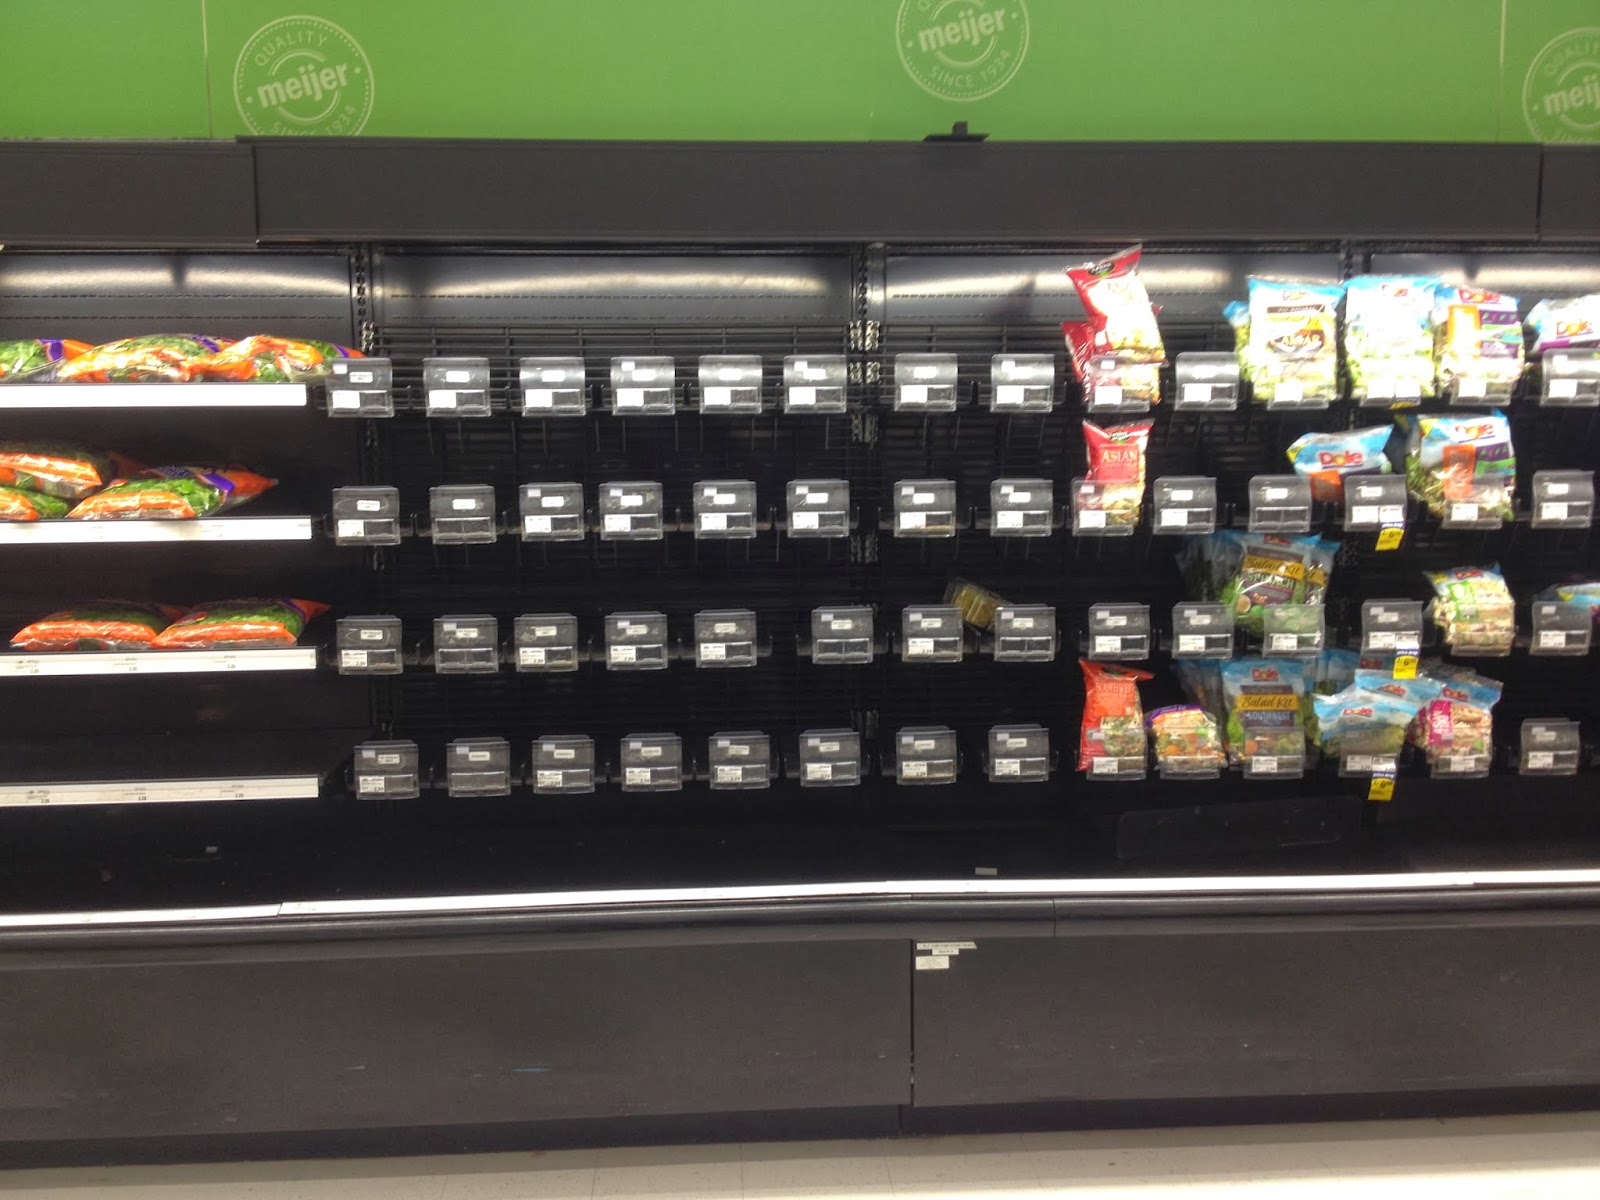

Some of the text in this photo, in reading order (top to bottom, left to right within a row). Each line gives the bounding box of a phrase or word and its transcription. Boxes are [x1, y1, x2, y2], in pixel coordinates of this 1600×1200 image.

[918, 8, 1005, 52] meijer
[255, 31, 328, 66] QUALITY
[928, 65, 976, 88] SINCE
[257, 63, 347, 108] meijer
[1544, 73, 1600, 116] meij
[1101, 450, 1138, 463] ASIAN
[1319, 450, 1363, 467] Dole
[1252, 668, 1279, 680] Dole
[1242, 696, 1292, 709] Salad Kit
[1246, 711, 1290, 720] SOUTHWEST
[1343, 707, 1373, 717] Dole
